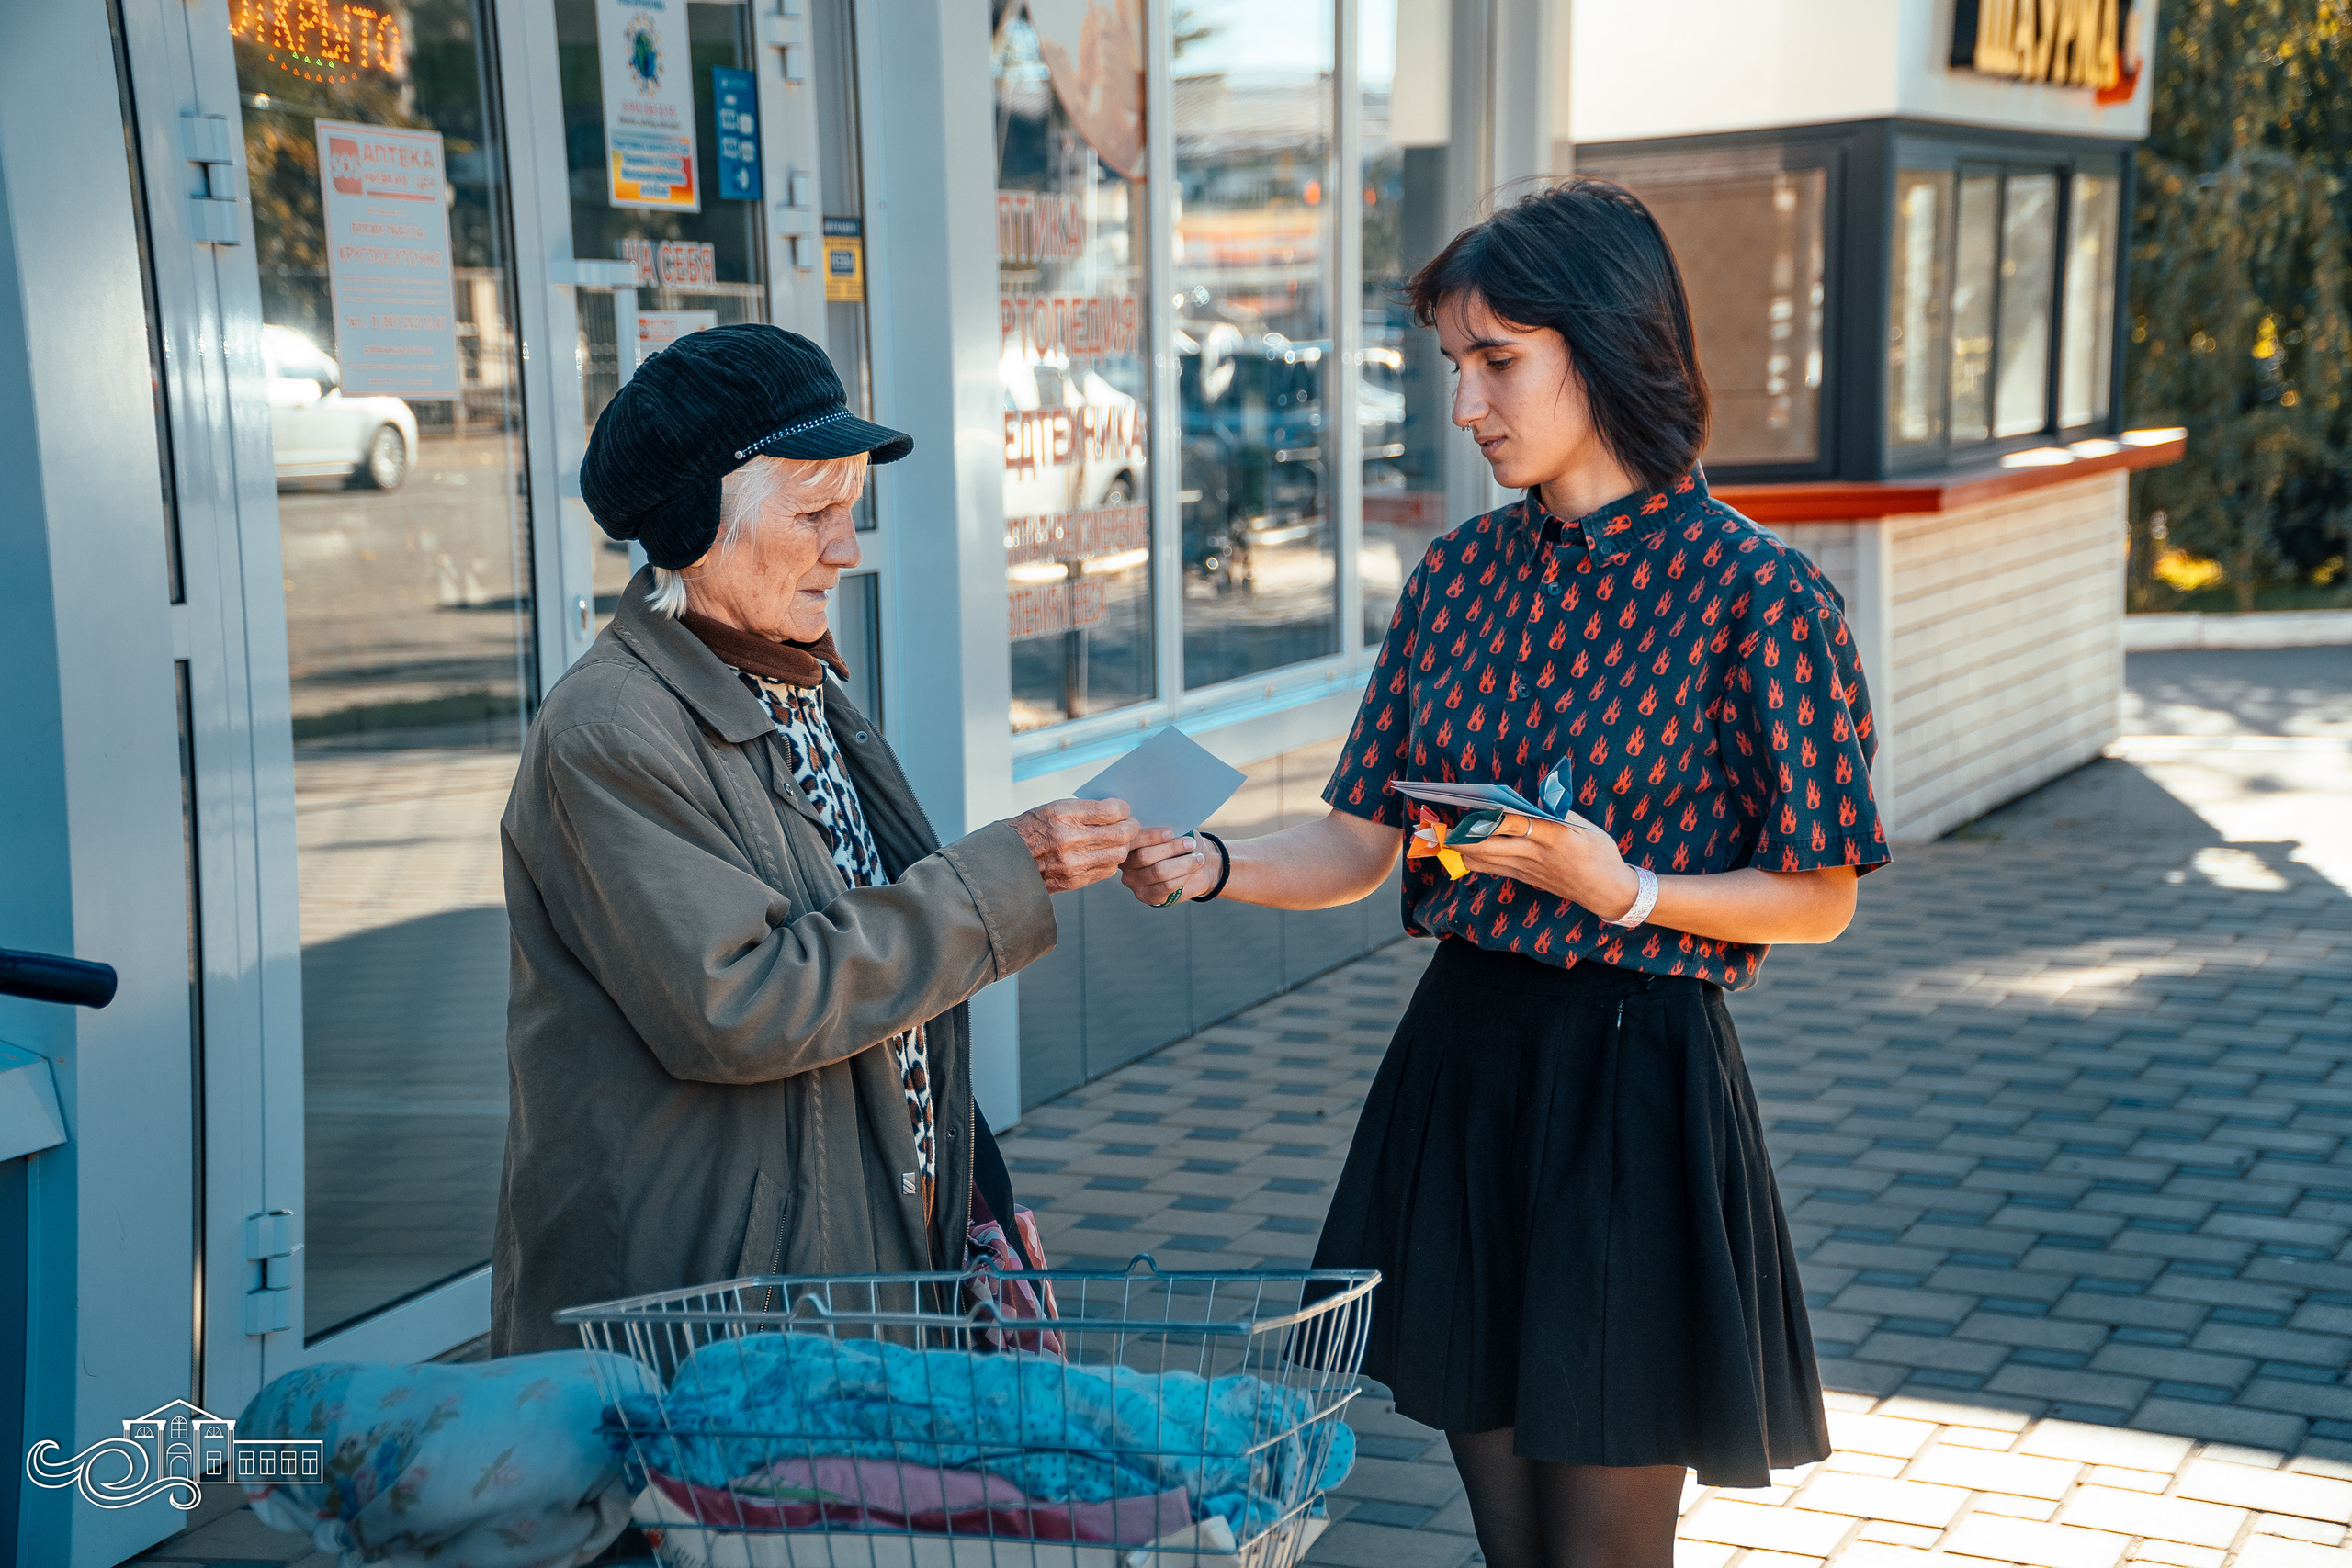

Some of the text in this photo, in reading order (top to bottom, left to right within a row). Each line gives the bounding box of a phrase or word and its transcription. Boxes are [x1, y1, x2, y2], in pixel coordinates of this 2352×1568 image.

[332, 152, 362, 180] SOS
[363, 142, 435, 169] АПТЕКА
[338, 245, 442, 268] КРУГЛОСУТОЧНО
[661, 245, 713, 285] СЕБЯ
[1001, 296, 1136, 367] РТОПЕДИЯ
